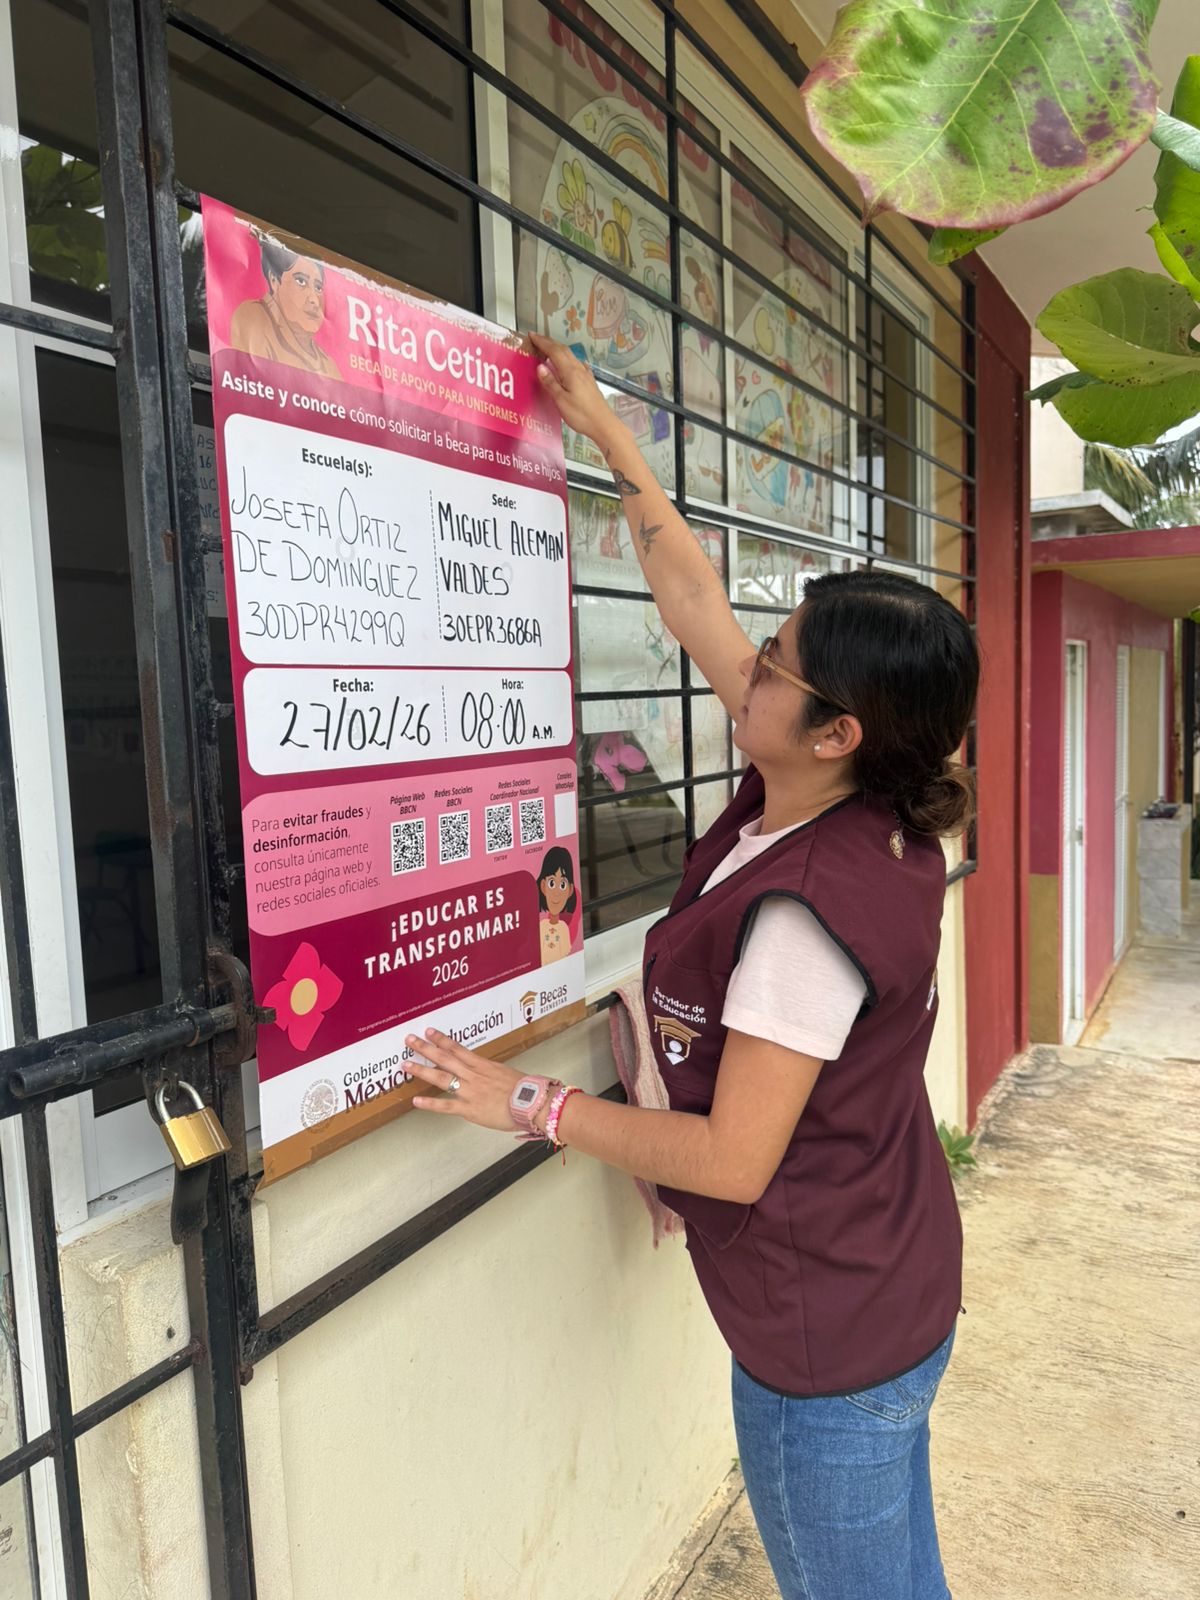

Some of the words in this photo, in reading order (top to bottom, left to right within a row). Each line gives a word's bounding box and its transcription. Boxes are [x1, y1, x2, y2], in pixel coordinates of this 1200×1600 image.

[346, 295, 418, 363] Rita
[425, 328, 515, 401] Cetina
[350, 354, 382, 375] BECA
[383, 363, 398, 382] DE
[400, 373, 436, 396] APOYO
[438, 385, 464, 406] PARA
[467, 396, 519, 425] UNIFORMES
[519, 414, 525, 428] Y
[222, 370, 275, 400] Asiste
[278, 389, 288, 408] y
[292, 394, 346, 420] conoce
[349, 407, 386, 430] cómo
[388, 417, 431, 443] solicitar
[434, 430, 443, 447] la
[445, 433, 470, 455] beca
[472, 445, 494, 461] para
[496, 451, 511, 466] tus
[512, 455, 533, 474] hijas
[534, 464, 540, 475] e
[541, 463, 563, 482] hijos.
[302, 447, 373, 478] Escuela(s):
[231, 466, 332, 539] JOSEFA
[338, 487, 407, 553] ORTIZ
[492, 493, 517, 510] Sede:
[438, 501, 502, 551] MIGUEL
[511, 520, 564, 563] ALEMAN
[231, 530, 277, 577] DE
[282, 540, 421, 600] DOMINGUEZ
[440, 557, 510, 596] VALDES
[246, 601, 405, 648] 30DPR4299Q
[443, 613, 542, 648] 30EPR3686A
[332, 678, 374, 693] Fecha:
[501, 678, 524, 691] Hora:
[279, 695, 431, 752] 27/02/26
[460, 692, 526, 749] 08:00
[532, 725, 556, 740] A.M.
[390, 794, 412, 806] Página
[412, 791, 426, 801] Web
[434, 788, 451, 799] Redes
[451, 785, 473, 796] Sociales
[490, 789, 519, 801] Coordinador
[519, 786, 540, 797] Nacional
[498, 780, 512, 789] Redes
[512, 778, 531, 788] Sociales
[251, 818, 280, 833] Para
[283, 812, 318, 829] evitar
[321, 805, 364, 823] fraudes
[365, 805, 372, 820] y
[399, 805, 417, 815] BBCN
[446, 797, 463, 808] BBCN
[252, 826, 351, 853] desinformación,
[254, 853, 305, 874] consulta
[307, 842, 369, 864] únicamente
[255, 874, 301, 894] nuestra
[304, 865, 341, 887] página
[342, 860, 365, 876] web
[366, 860, 372, 874] y
[256, 896, 291, 914] redes
[294, 885, 337, 906] sociales
[338, 876, 381, 896] oficiales.
[391, 894, 479, 943] ¡EDUCAR
[485, 887, 505, 910] ES
[364, 910, 521, 980] TRANSFORMAR!
[431, 955, 470, 987] 2026
[540, 984, 568, 1007] Becas
[659, 998, 707, 1024] Educación
[692, 1004, 705, 1014] de
[446, 1010, 504, 1043] ducación
[343, 1053, 399, 1087] Gobierno
[401, 1046, 416, 1061] de
[344, 1069, 416, 1114] México
